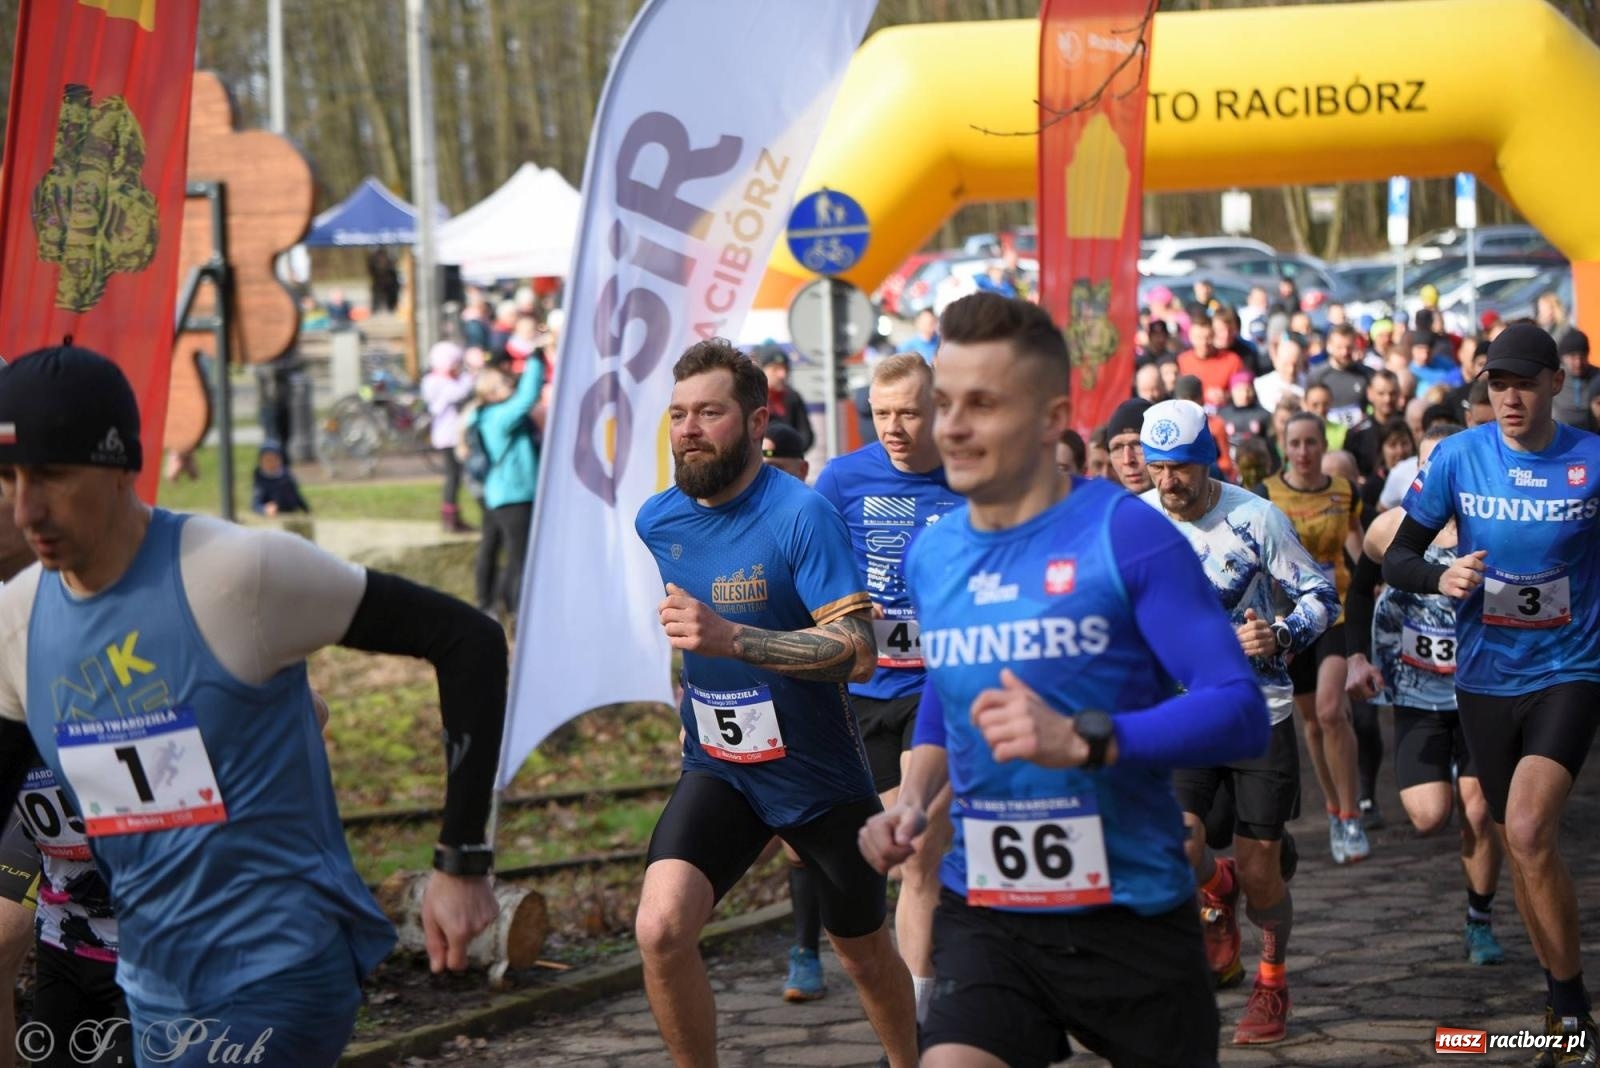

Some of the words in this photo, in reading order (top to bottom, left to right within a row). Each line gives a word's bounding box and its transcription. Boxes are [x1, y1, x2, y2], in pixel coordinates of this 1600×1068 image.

[1215, 75, 1428, 121] RACIBÓRZ
[1459, 492, 1600, 522] RUNNERS
[713, 581, 766, 601] SILESIAN
[1518, 587, 1541, 616] 3
[887, 622, 921, 653] 4
[920, 615, 1110, 669] UNNERS
[1416, 635, 1455, 661] 83
[711, 689, 759, 700] TWARDZIELA
[714, 709, 743, 746] 5
[114, 745, 156, 804] 1
[992, 823, 1074, 880] 66
